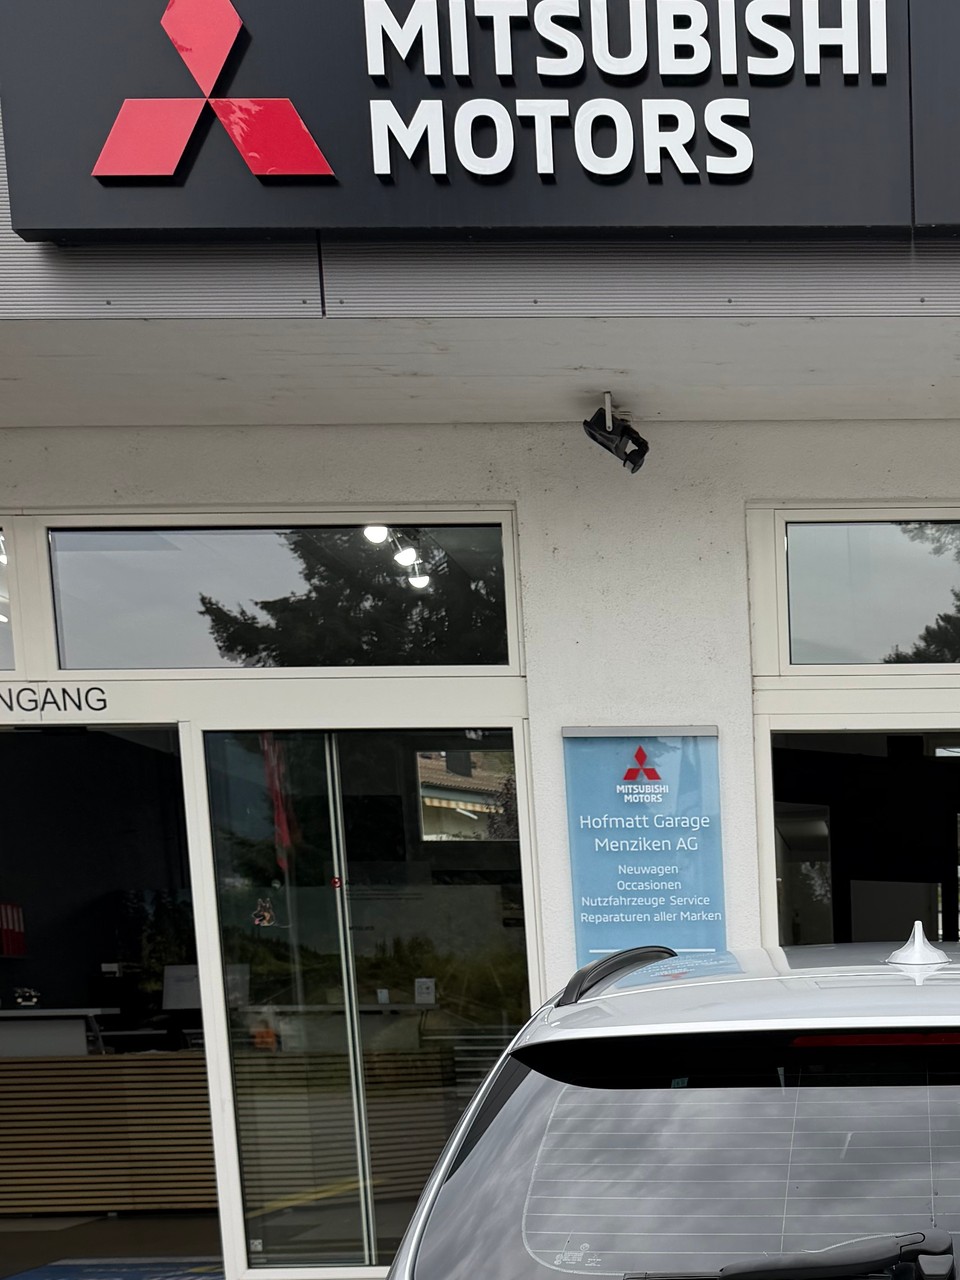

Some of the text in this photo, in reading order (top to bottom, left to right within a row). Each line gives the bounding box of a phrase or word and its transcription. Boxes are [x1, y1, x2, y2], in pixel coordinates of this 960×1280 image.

[363, 0, 889, 77] MITSUBISHI
[370, 98, 754, 176] MOTORS
[0, 687, 107, 712] NGANG
[616, 785, 669, 793] MITSUBISHI
[624, 794, 663, 803] MOTORS
[579, 814, 710, 830] Hofmatt Garage
[595, 837, 698, 851] Menziken AG
[618, 865, 679, 877] Neuwagen
[617, 880, 682, 891] Occasionen
[581, 895, 710, 908] Nutzfahrzeuge Service
[580, 911, 722, 924] Reparaturen aller Marken
